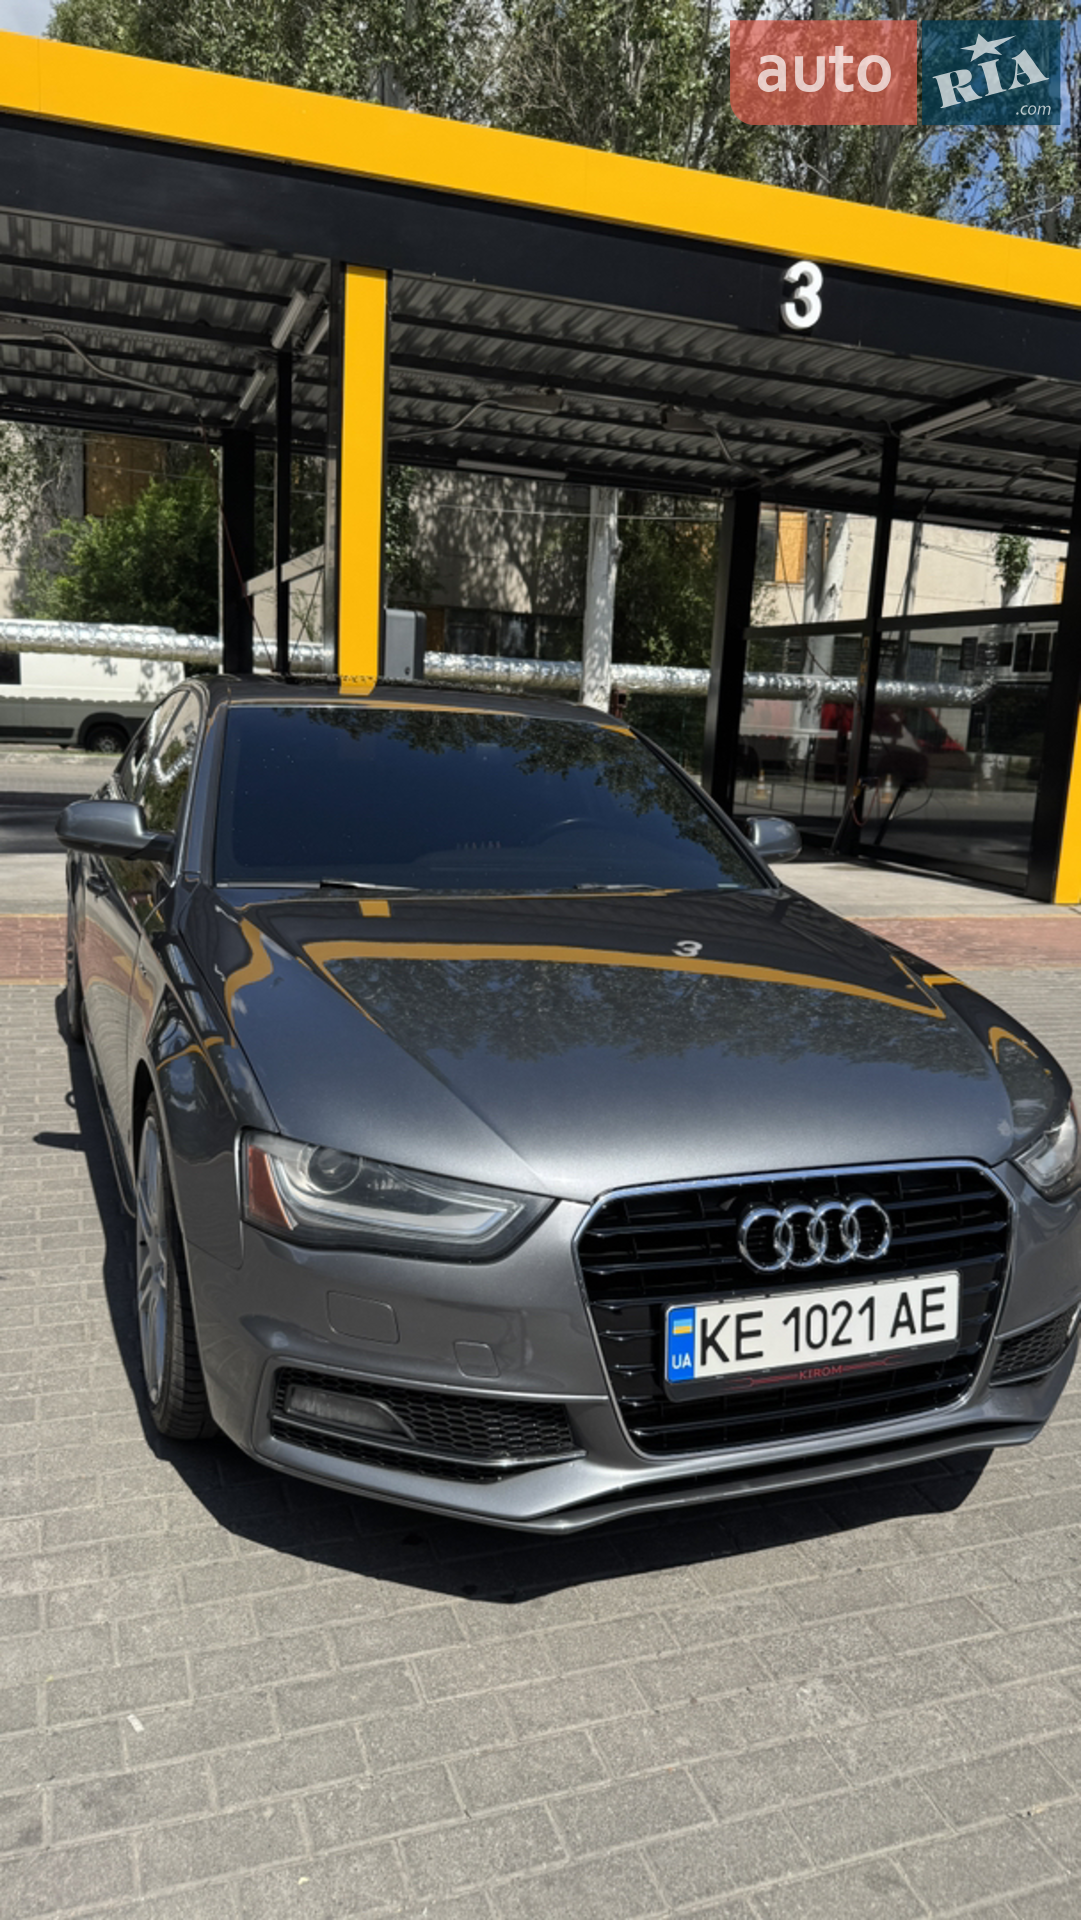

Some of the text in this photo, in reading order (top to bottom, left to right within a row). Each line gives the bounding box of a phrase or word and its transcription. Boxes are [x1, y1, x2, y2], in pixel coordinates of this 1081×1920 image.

[780, 261, 823, 330] 3
[701, 1286, 946, 1366] KE 1021 AE
[671, 1352, 693, 1370] UA
[799, 1365, 844, 1380] KIROM
